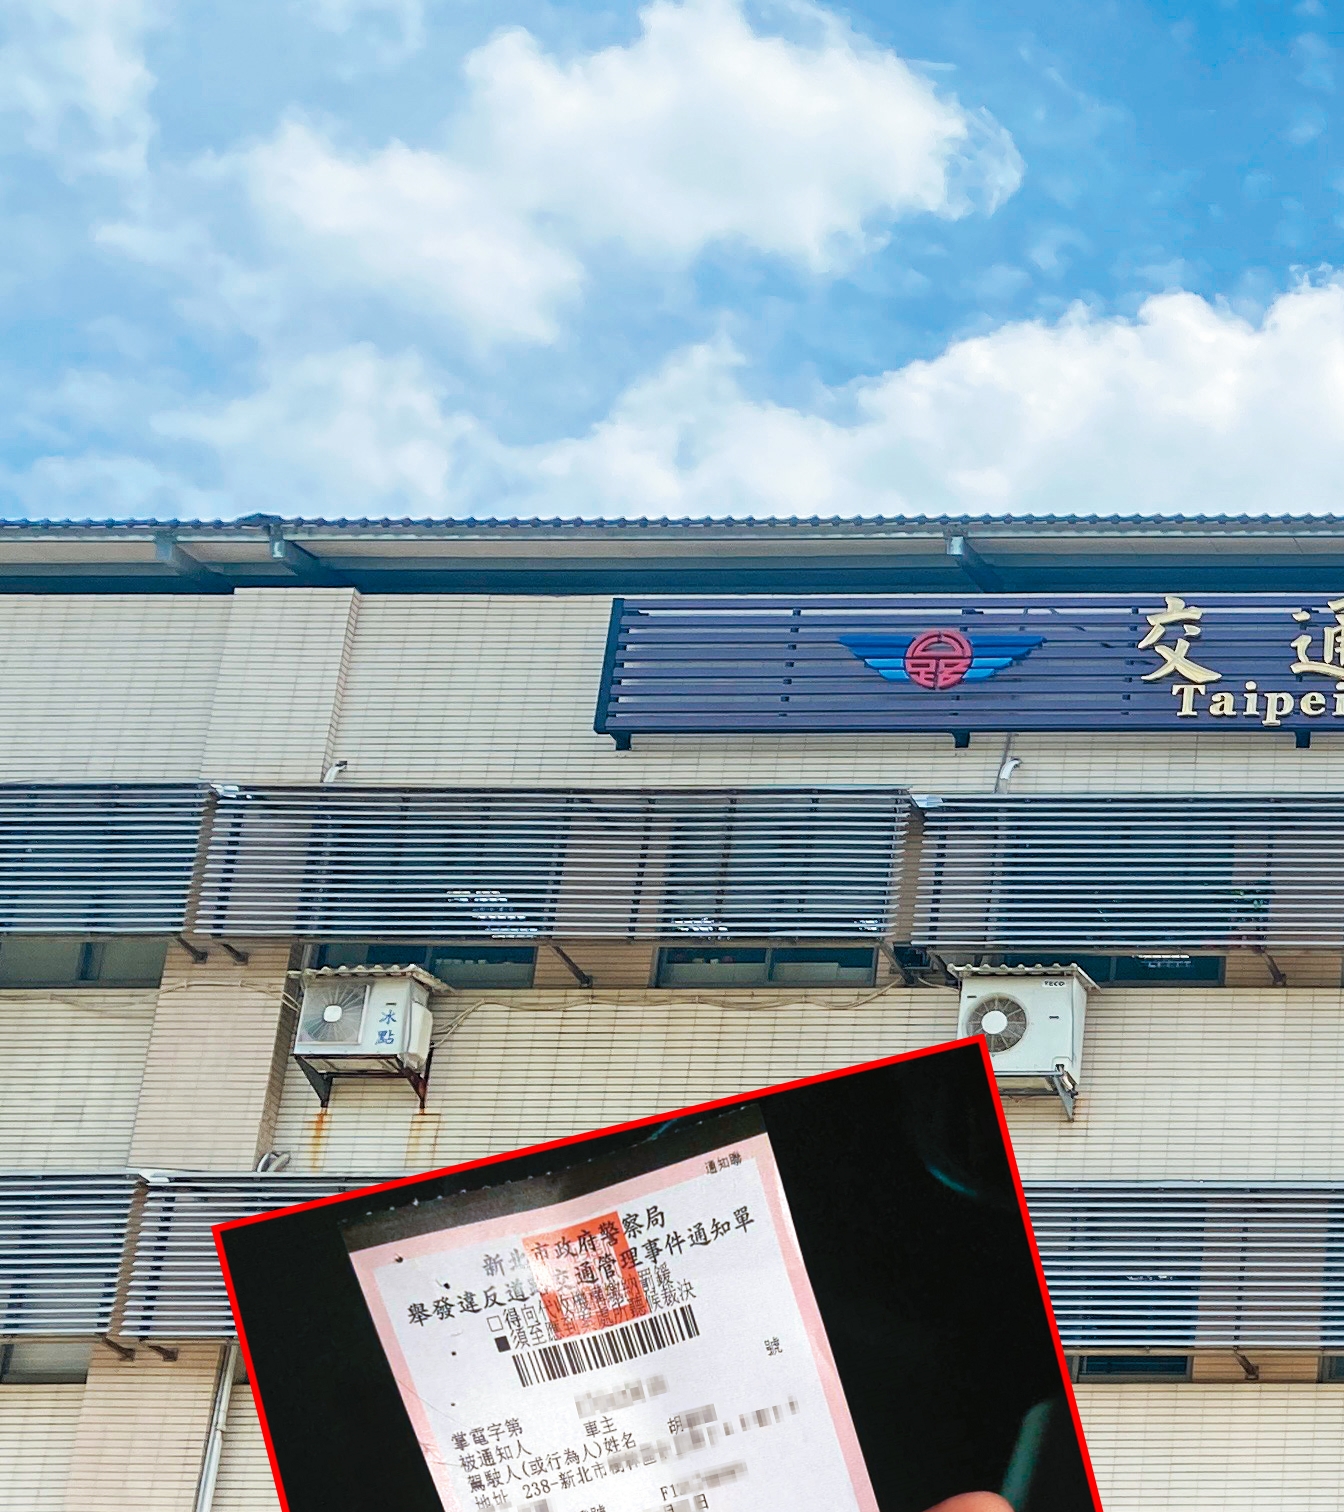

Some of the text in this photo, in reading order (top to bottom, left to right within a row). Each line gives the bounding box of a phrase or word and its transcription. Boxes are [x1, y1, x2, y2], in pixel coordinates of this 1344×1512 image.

[705, 1151, 743, 1175] 通知聯
[482, 1206, 666, 1277] 新北市政府警察局
[450, 1417, 524, 1451] 掌電字第
[460, 1416, 618, 1473] 被通知人 車主
